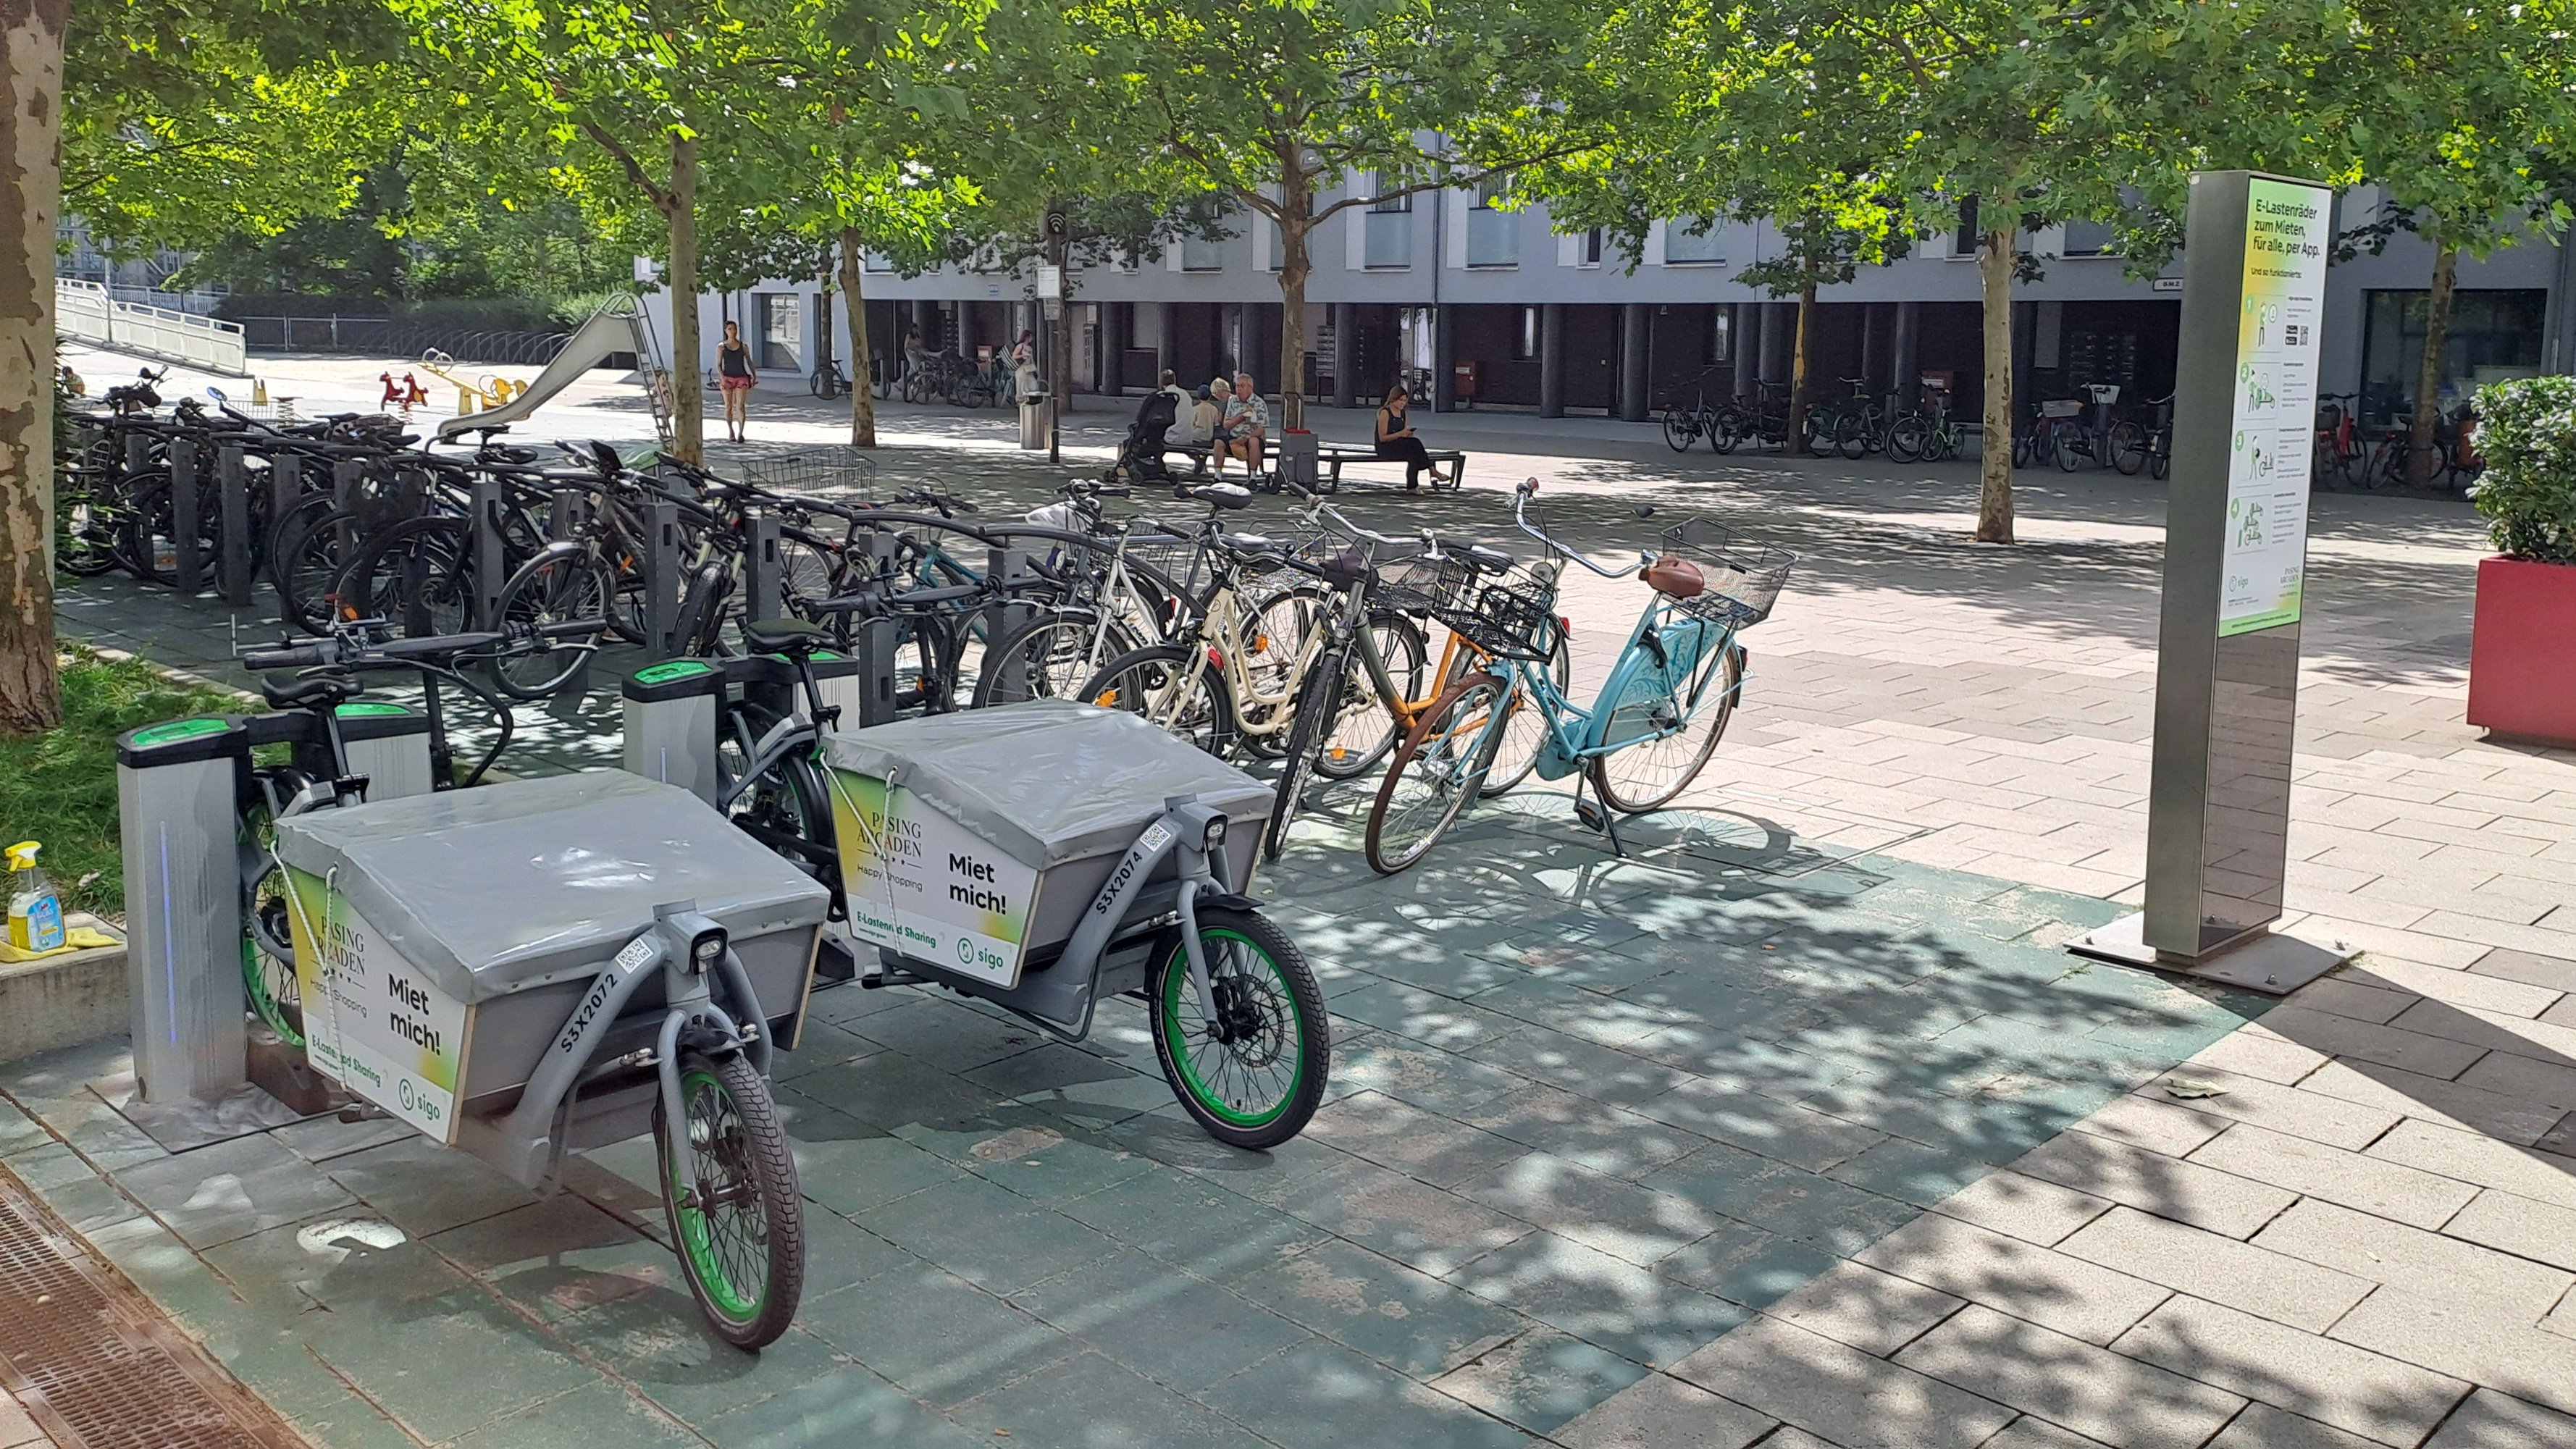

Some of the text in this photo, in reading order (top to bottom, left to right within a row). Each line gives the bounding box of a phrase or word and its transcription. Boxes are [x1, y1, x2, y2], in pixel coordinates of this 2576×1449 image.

[2255, 198, 2317, 219] E-Lastenräder
[2254, 219, 2306, 239] zum Mieten,
[2253, 236, 2320, 259] für alle, per App.
[2251, 267, 2262, 276] Und
[2241, 367, 2247, 377] 2
[2237, 576, 2249, 589] sigo
[949, 853, 995, 883] Miet
[886, 872, 923, 893] hopping
[1096, 851, 1143, 915] S3X2074
[949, 883, 1006, 915] mich!
[905, 926, 936, 949] Sharing
[978, 947, 1004, 970] sigo
[333, 989, 367, 1018] Shopping
[388, 973, 429, 1016] Miet
[561, 973, 618, 1053] S3X2072
[390, 1012, 440, 1056] mich!
[353, 1057, 381, 1088] Sharing
[417, 1093, 440, 1121] sigo
